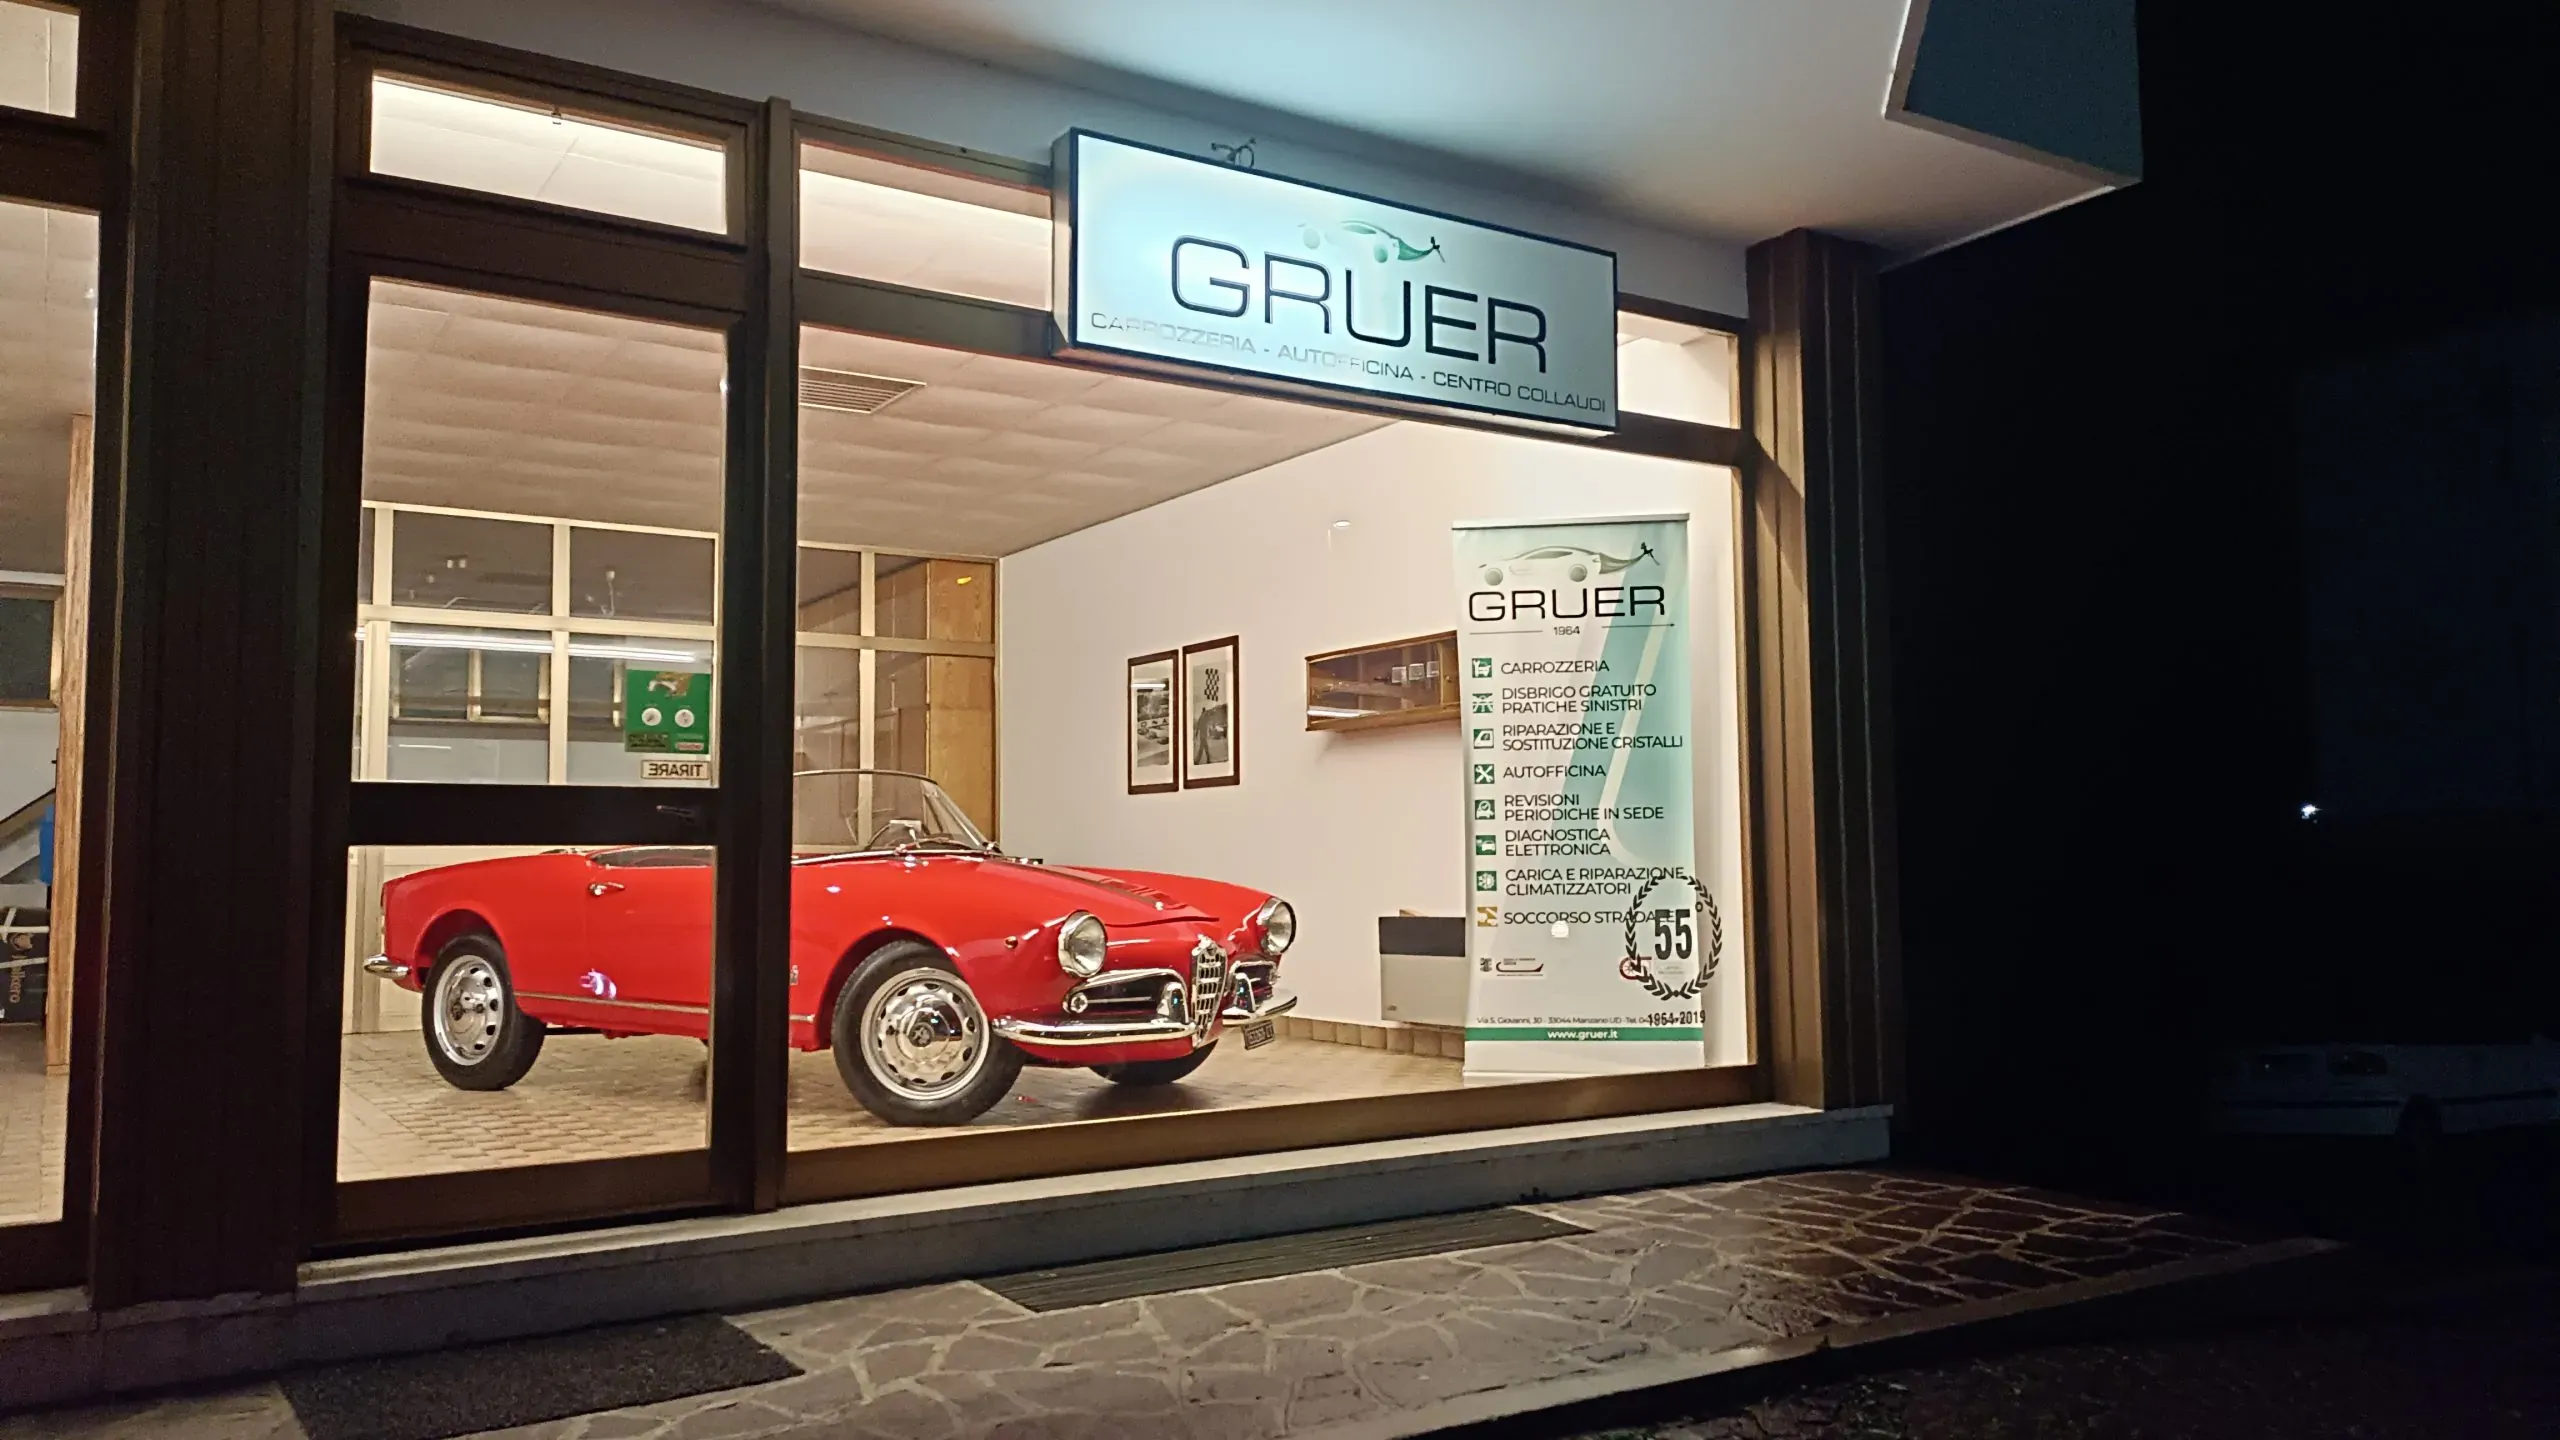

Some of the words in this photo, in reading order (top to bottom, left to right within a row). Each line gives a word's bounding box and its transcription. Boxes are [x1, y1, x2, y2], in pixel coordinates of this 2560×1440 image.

[1171, 235, 1547, 373] GRUER
[1091, 312, 1256, 354] CARROZZERIA
[1277, 344, 1414, 381] AUTOFFICINA
[1433, 371, 1511, 397] CENTRO
[1517, 385, 1606, 413] COLLAUDI
[1469, 585, 1665, 621] GRUER
[1553, 626, 1581, 635] 1964
[1500, 660, 1610, 674] CARROZZERIA
[1502, 686, 1576, 700] DISBRIGO
[1579, 684, 1656, 697] GRATUITO
[1502, 700, 1577, 714] PRATICHE
[1580, 699, 1642, 712] SINISTRI
[1503, 723, 1603, 736] RIPARAZIONE
[1606, 722, 1615, 734] E
[1503, 737, 1609, 751] SOSTITUZIONE
[1611, 736, 1683, 749] CRISTALLI
[1503, 764, 1606, 779] AUTOFFICINA
[1504, 794, 1580, 807] REVISIONI
[1504, 808, 1600, 822] PERIODICHE
[1603, 807, 1620, 819] IN
[1623, 806, 1665, 819] SEDE
[1505, 828, 1610, 842] DIAGNOSTICA
[1505, 844, 1611, 856] ELETTRONICA
[1505, 869, 1563, 882] CARICA
[1566, 868, 1576, 880] E
[1579, 867, 1684, 879] RIPARAZIONE
[1506, 883, 1631, 896] CLIMATIZZATORI
[1504, 912, 1591, 925] SOCCORSO
[1648, 1010, 1706, 1026] 1964-2019
[1547, 1029, 1619, 1040] www.gruer.it
